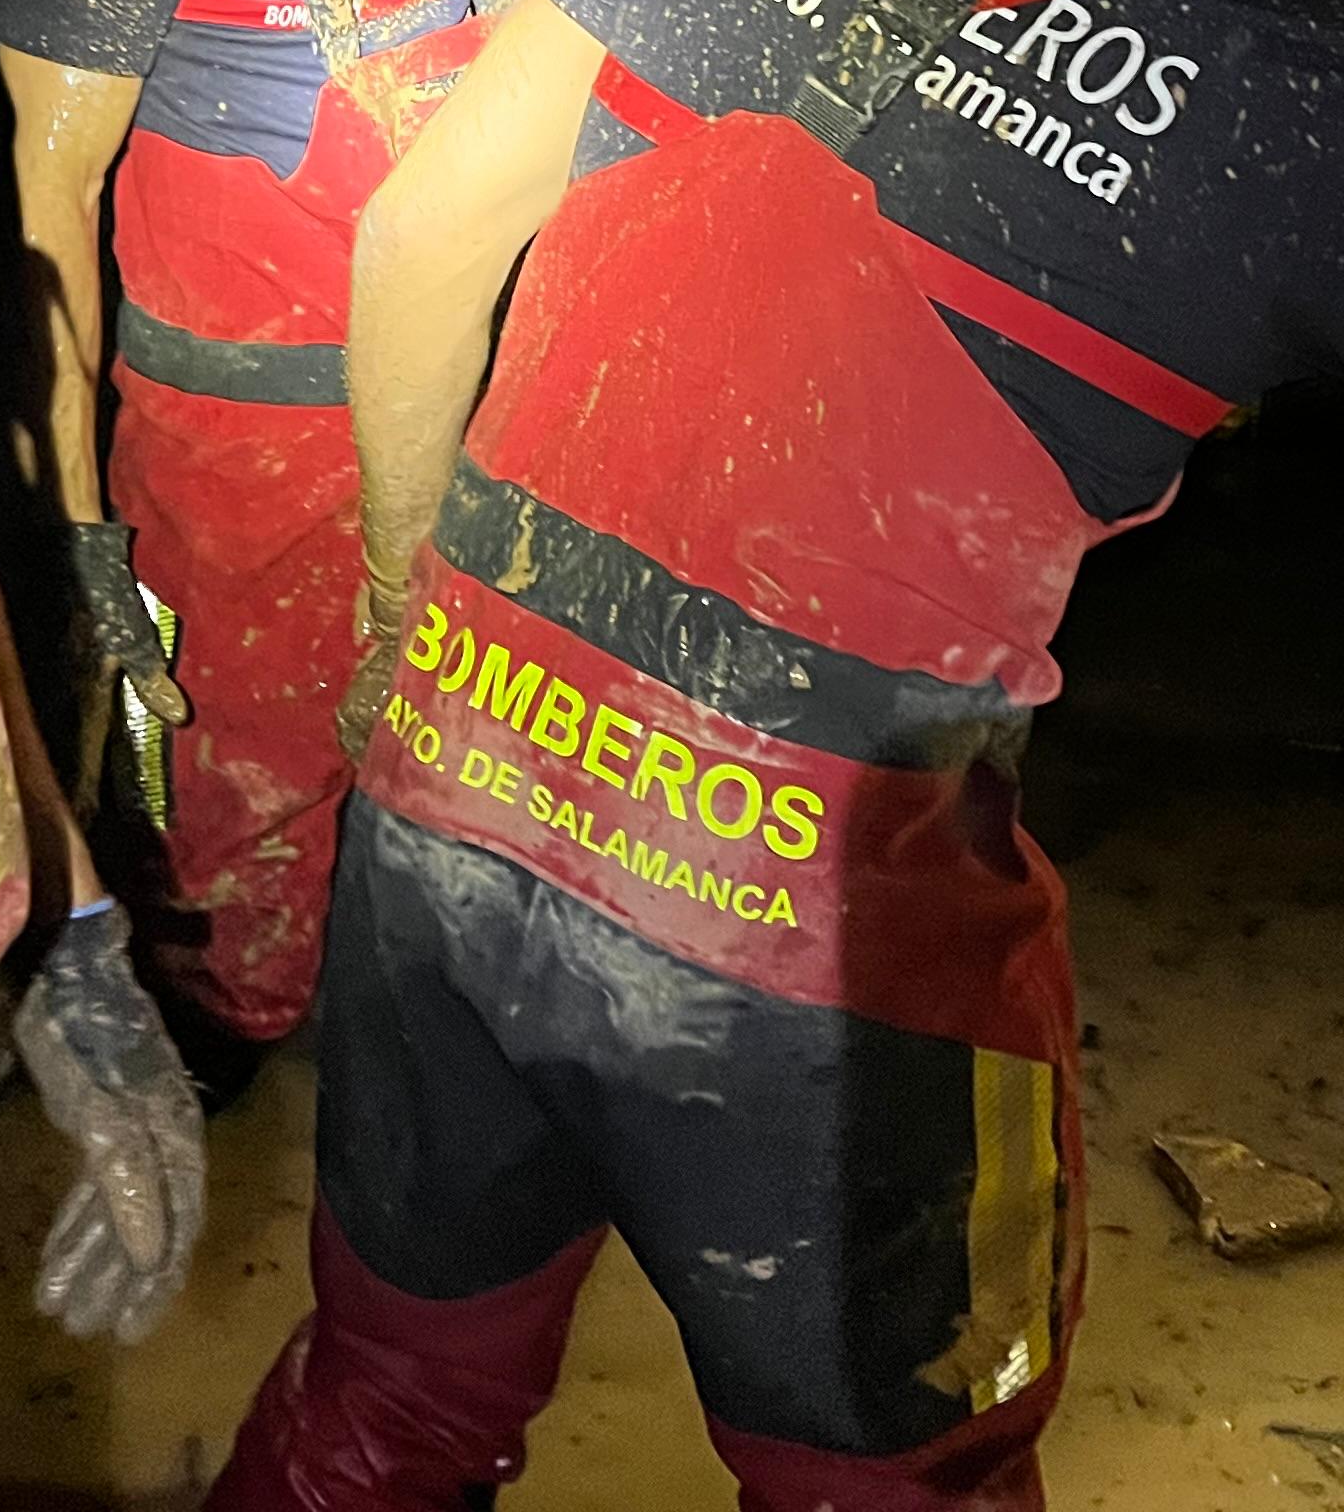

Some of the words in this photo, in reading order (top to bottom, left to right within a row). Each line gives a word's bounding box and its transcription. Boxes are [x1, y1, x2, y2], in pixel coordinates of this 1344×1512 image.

[405, 602, 825, 861] BOMBEROS
[458, 749, 523, 805] DE
[527, 784, 799, 928] SALAMANCA
